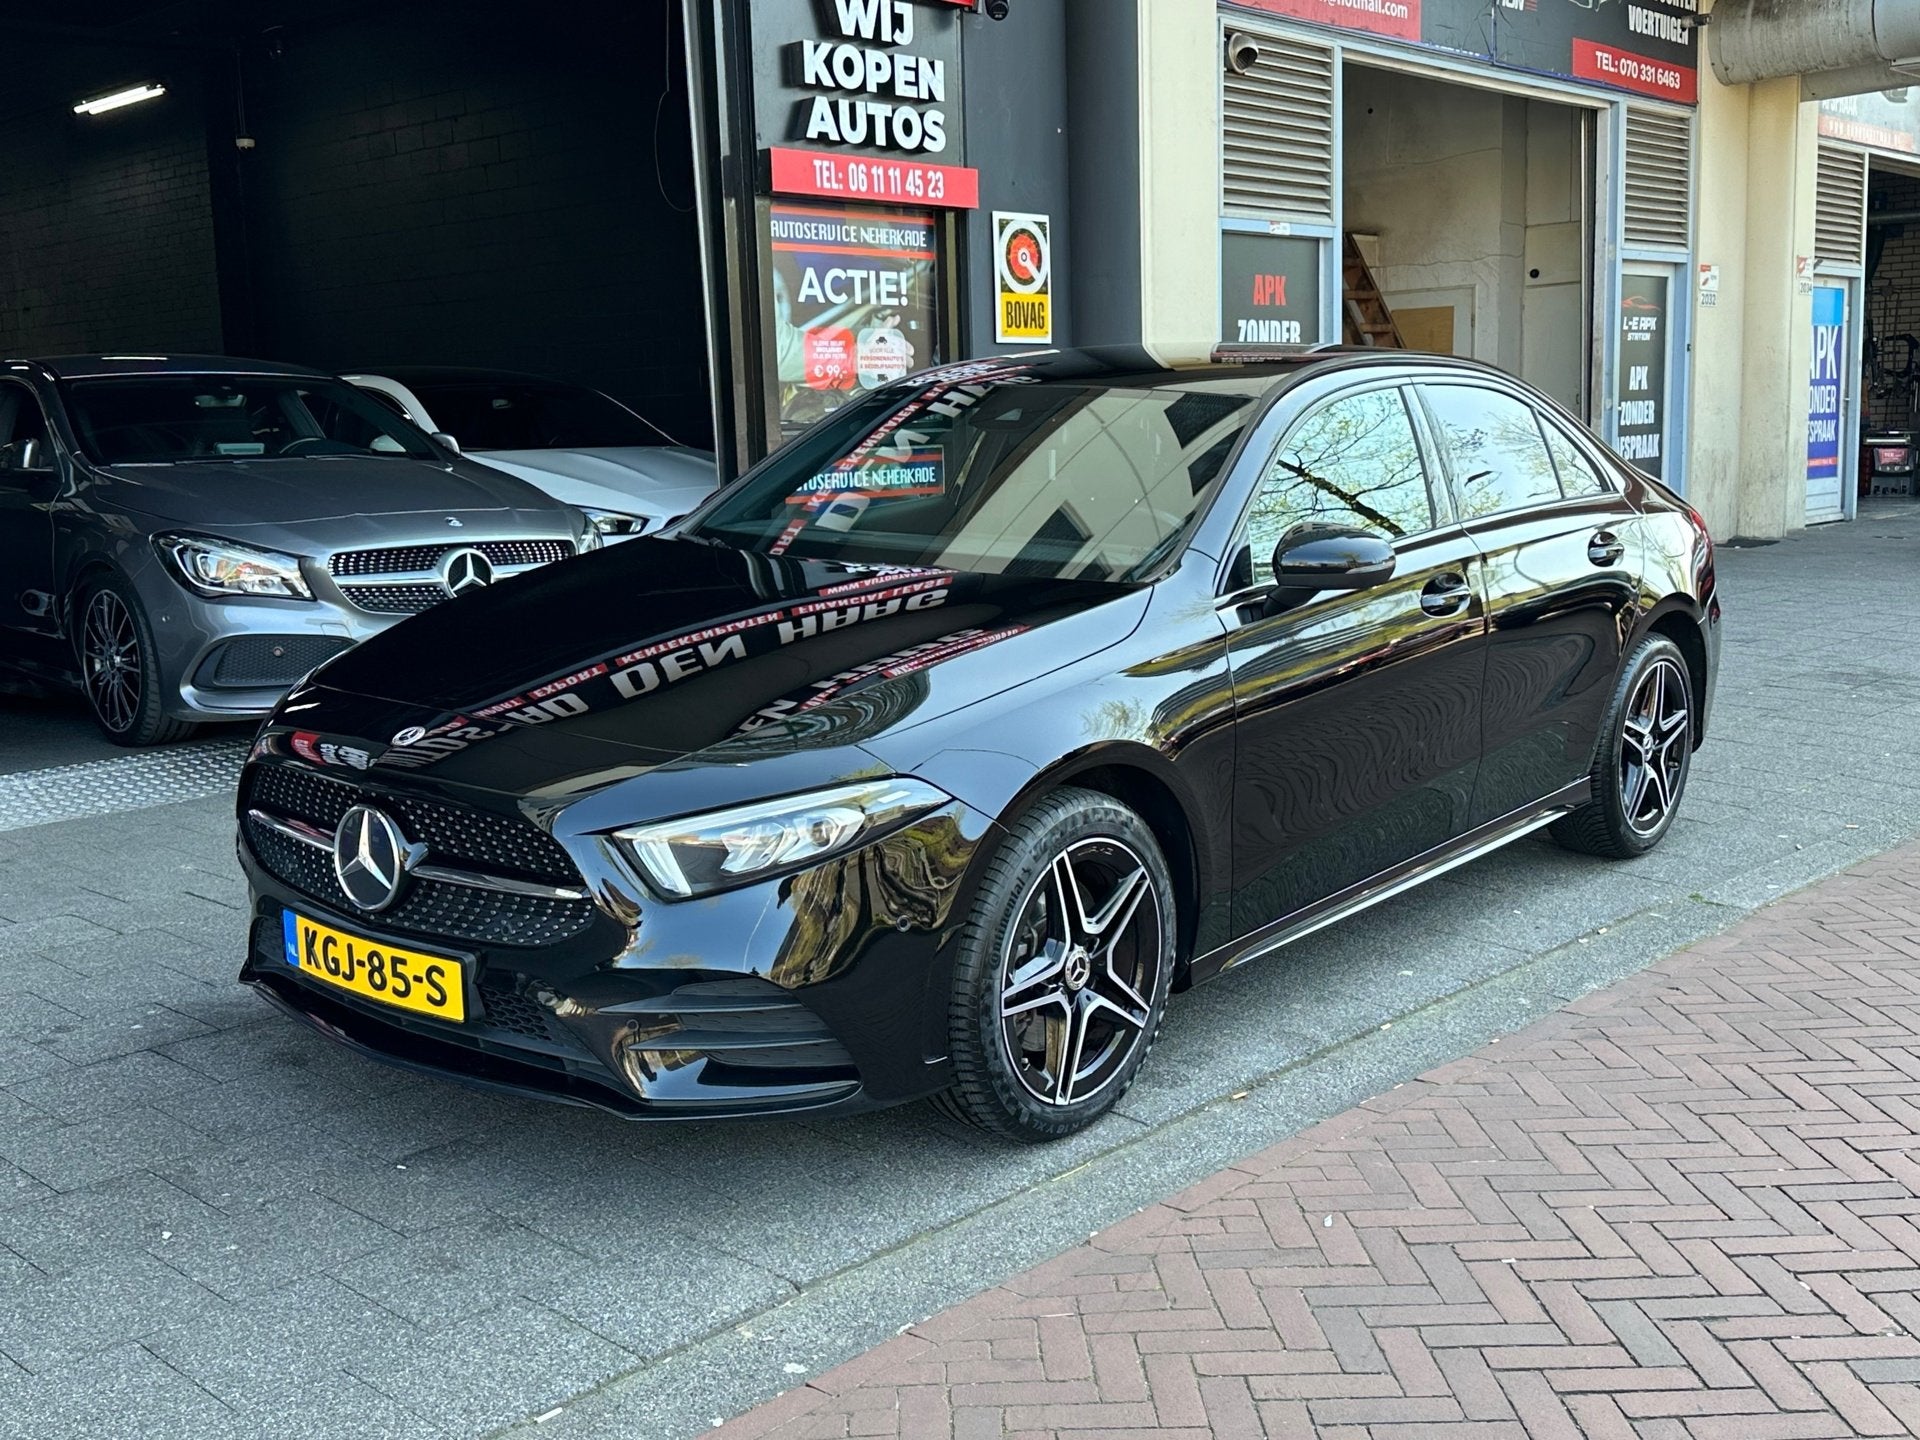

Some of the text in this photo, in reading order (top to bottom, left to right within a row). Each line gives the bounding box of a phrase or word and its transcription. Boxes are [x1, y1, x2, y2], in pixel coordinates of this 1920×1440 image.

[835, 0, 914, 46] WIJ
[803, 39, 945, 102] KOPEN
[1595, 51, 1618, 73] TEL:
[1620, 58, 1639, 79] 070
[1657, 68, 1681, 90] 6463
[806, 96, 946, 152] AUTOS
[813, 159, 945, 199] TEL: 06 11 11 45 23
[770, 220, 927, 247] AUTOSERVICE NEHERKADE
[798, 266, 909, 307] ACTIE!
[1253, 274, 1287, 306] APK
[1006, 301, 1045, 330] BOVAG
[1237, 319, 1301, 343] ZONDER
[814, 365, 824, 378] €
[1629, 366, 1649, 391] APK
[1620, 400, 1655, 426] ZONDER
[1808, 385, 1837, 414] ONDER
[1807, 419, 1836, 444] SPRAAK
[796, 466, 937, 492] TOSERVICE NEHERKADE
[287, 941, 298, 957] NL
[303, 925, 448, 1008] KGJ-85-S
